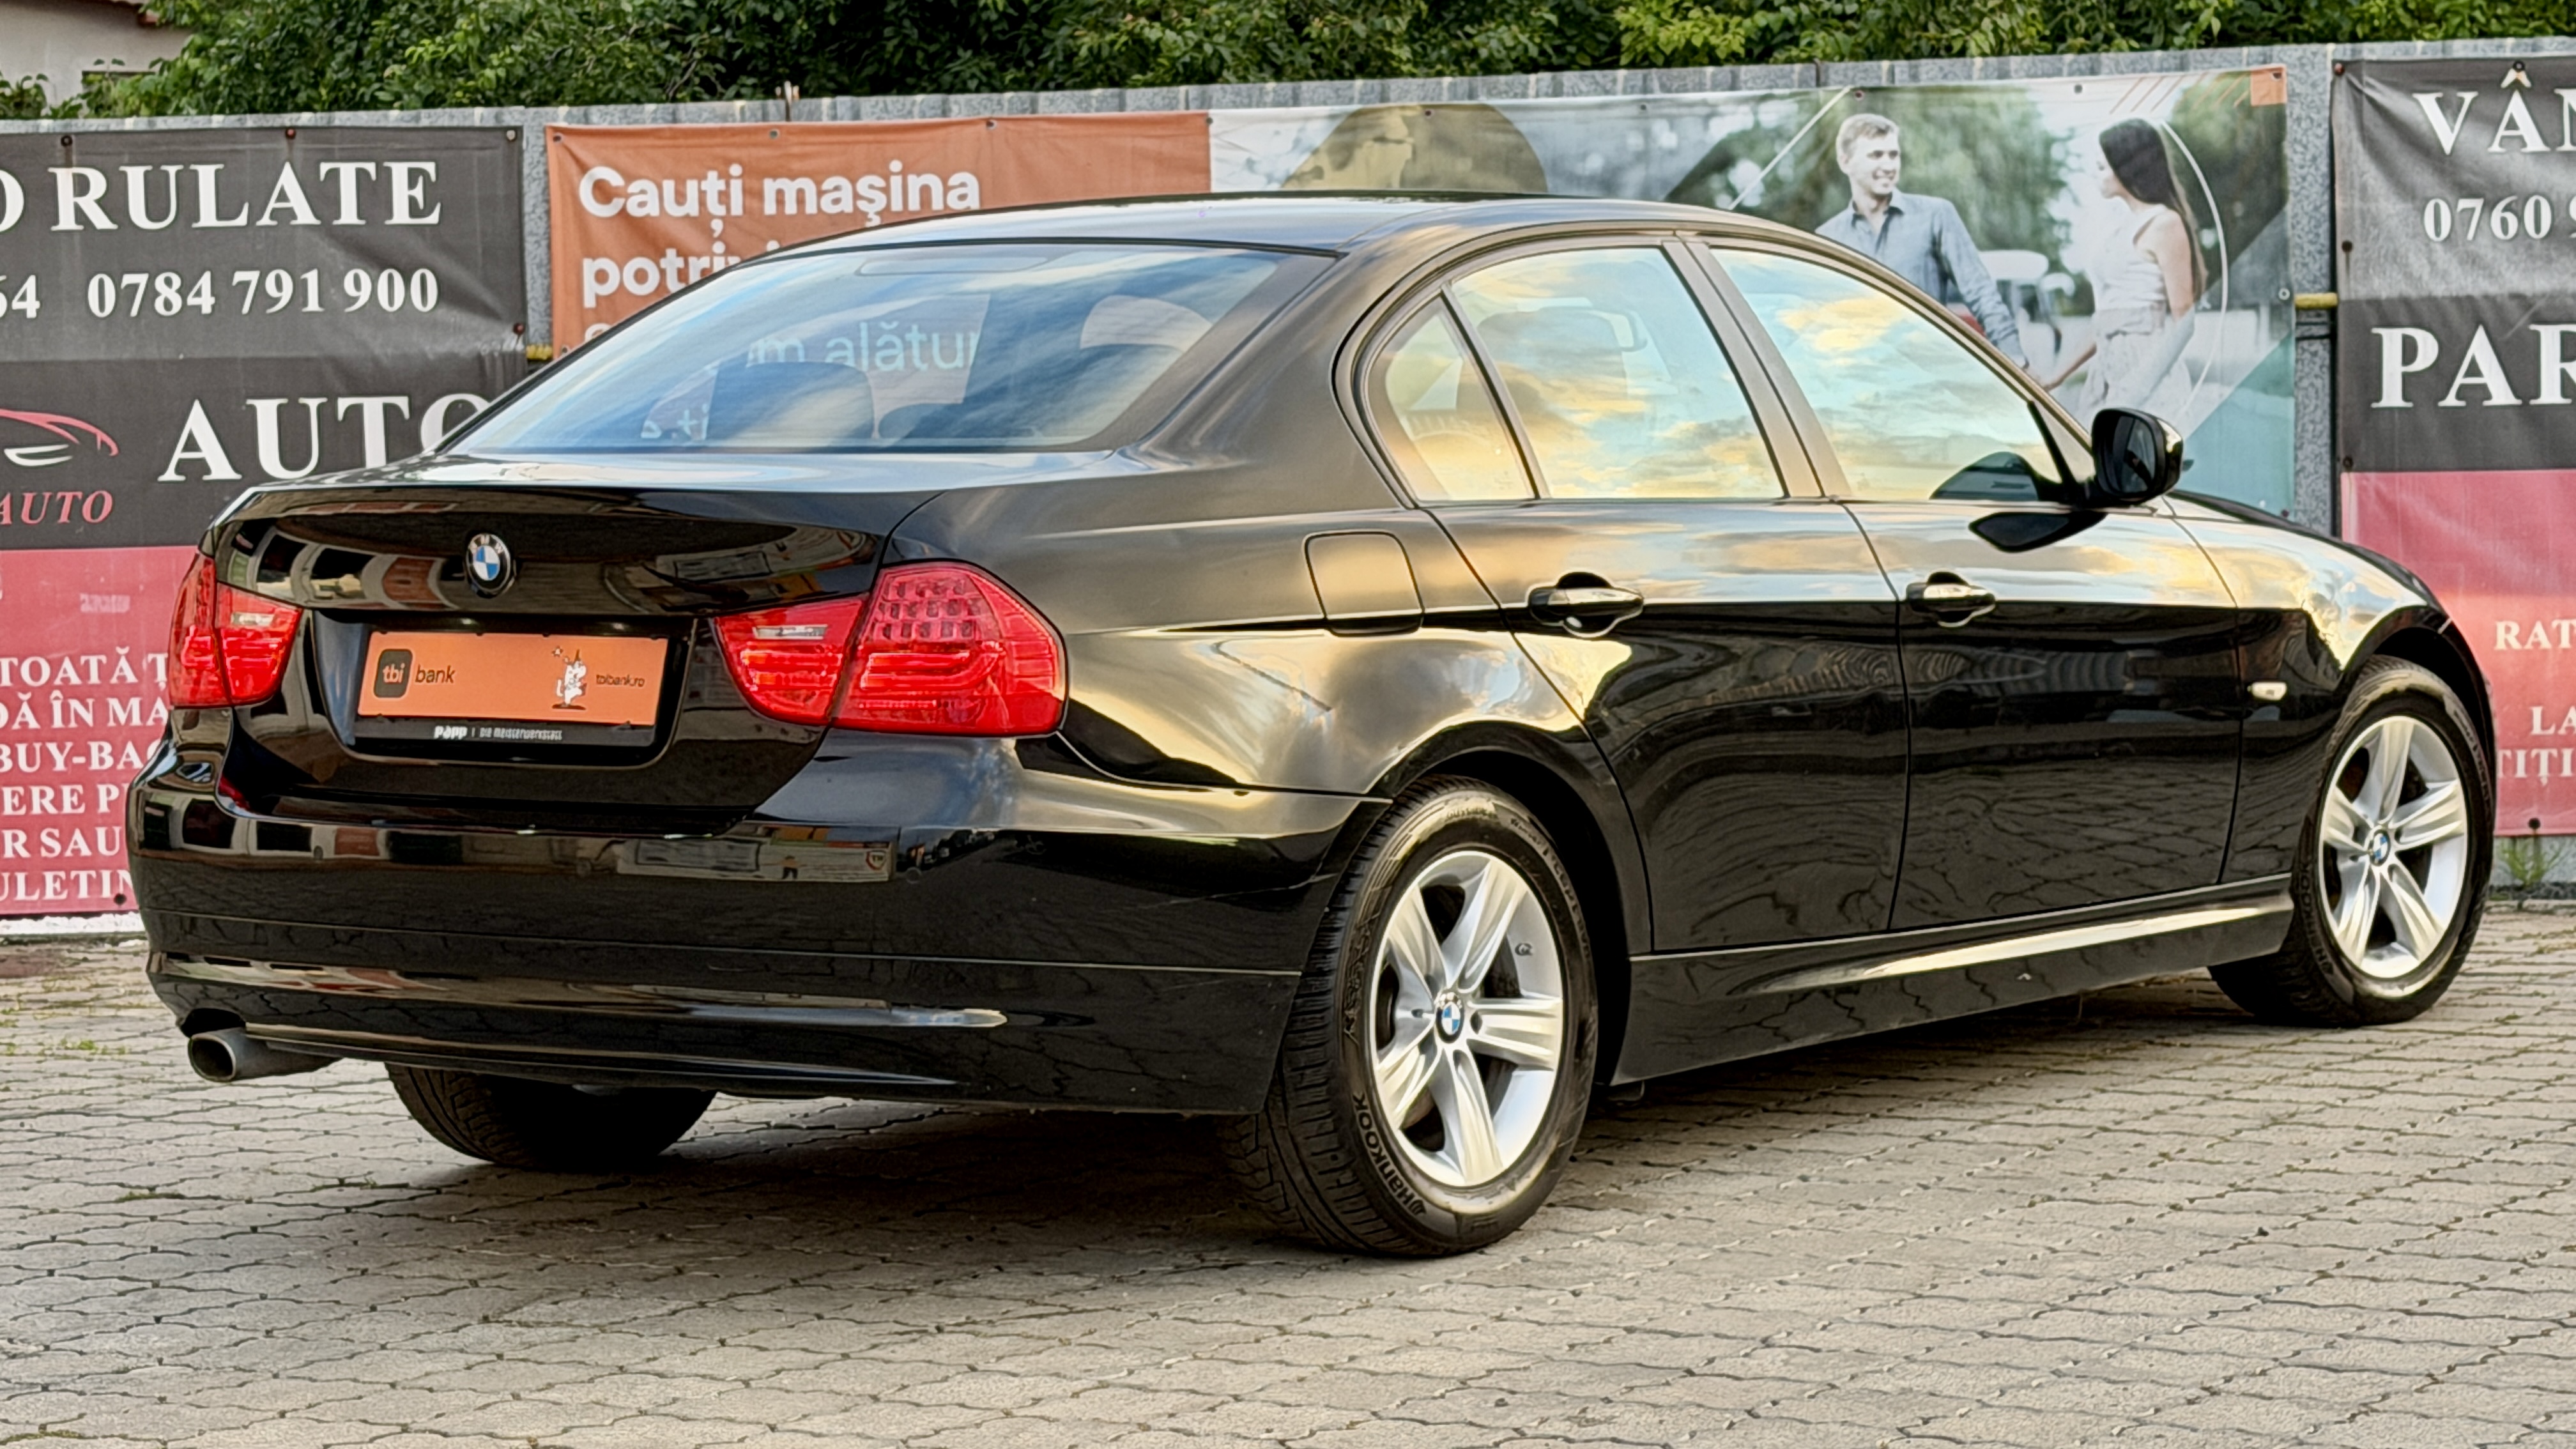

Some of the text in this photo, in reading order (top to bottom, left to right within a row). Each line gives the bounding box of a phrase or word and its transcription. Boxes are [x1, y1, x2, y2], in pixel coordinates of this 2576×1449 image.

[48, 162, 441, 231] RULATE
[579, 164, 743, 236] Cauți
[2424, 195, 2553, 242] 0760
[0, 268, 438, 318] 4 0784 791 900
[583, 240, 780, 309] potri
[2494, 618, 2576, 650] RAT
[383, 663, 456, 684] tbi bank
[0, 691, 41, 730] Ă
[50, 689, 95, 728] ÎN
[96, 782, 128, 814] P
[40, 826, 122, 858] SAU
